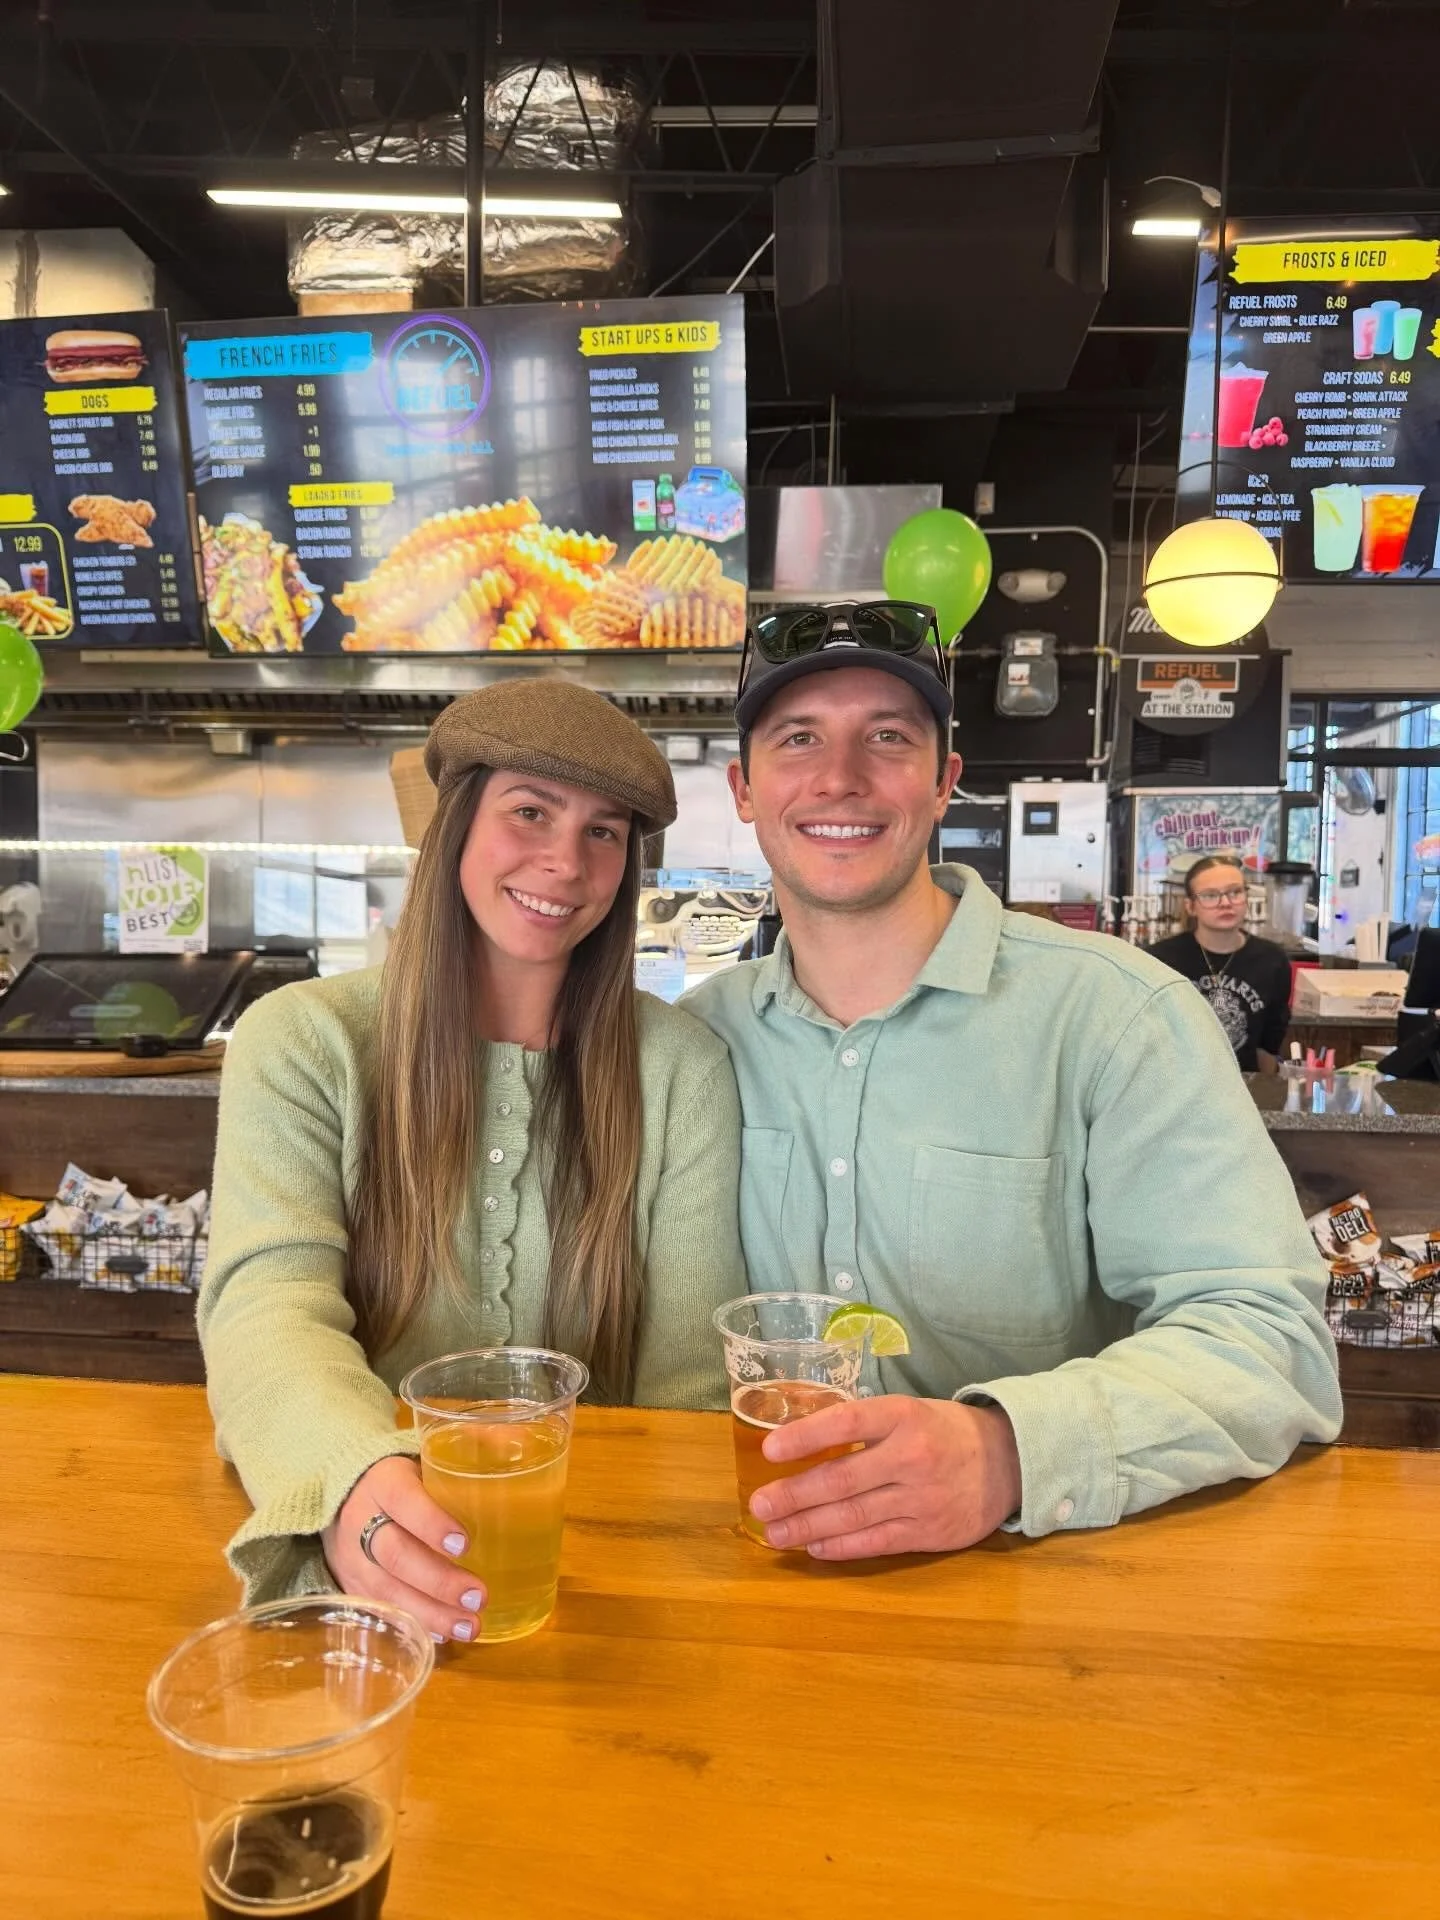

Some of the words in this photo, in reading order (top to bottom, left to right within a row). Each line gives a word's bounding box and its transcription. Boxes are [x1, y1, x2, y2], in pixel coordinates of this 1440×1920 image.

[1283, 252, 1336, 269] FROSTS
[1341, 252, 1349, 267] &
[1354, 251, 1387, 267] ICED
[1229, 296, 1262, 309] REFUEL
[1263, 295, 1298, 309] FROSTS
[1326, 296, 1347, 309] 6.49
[1240, 316, 1270, 327] CHERRY
[1299, 315, 1318, 326] BLUE
[1319, 314, 1340, 325] RAZZ
[592, 331, 630, 347] START
[636, 329, 660, 344] UPS
[665, 328, 673, 342] &
[678, 326, 707, 342] KIDS
[1263, 332, 1289, 344] GREEN
[1288, 331, 1312, 343] APPLE
[220, 345, 284, 368] FRENCH
[291, 343, 337, 365] FRIES
[1323, 371, 1352, 384] CRAFT
[1353, 371, 1384, 384] SODAS
[1389, 371, 1411, 384] 6.49
[81, 394, 109, 409] DOGS
[1295, 392, 1323, 403] CHERRY
[1324, 392, 1347, 403] BOMB
[1352, 391, 1378, 403] SHARK
[1378, 391, 1409, 402] ATTACK
[1297, 408, 1322, 419] PEACH
[1322, 408, 1347, 419] PUNCH
[1352, 408, 1378, 419] GREEN
[1378, 407, 1402, 419] APPLE
[1305, 425, 1355, 436] STRAWBERRY
[1355, 424, 1382, 435] CREAM
[1305, 441, 1352, 452] BLACKBERRY
[1352, 441, 1381, 452] BREEZE
[1291, 457, 1333, 468] RASPBERRY
[1340, 457, 1371, 468] VANILLA
[1371, 457, 1395, 468] CLOUD
[1216, 494, 1256, 505] LEMONADE
[1280, 494, 1295, 505] TEA
[14, 535, 42, 552] 12.99
[1154, 663, 1222, 679] REFUEL
[1143, 703, 1159, 714] AT
[1162, 703, 1181, 714] THE
[1184, 703, 1232, 715] STATION
[1185, 828, 1230, 849] drink
[125, 881, 196, 911] VOTE
[126, 911, 168, 932] BEST
[1331, 1207, 1361, 1227] METRO
[1335, 1217, 1370, 1242] DELI
